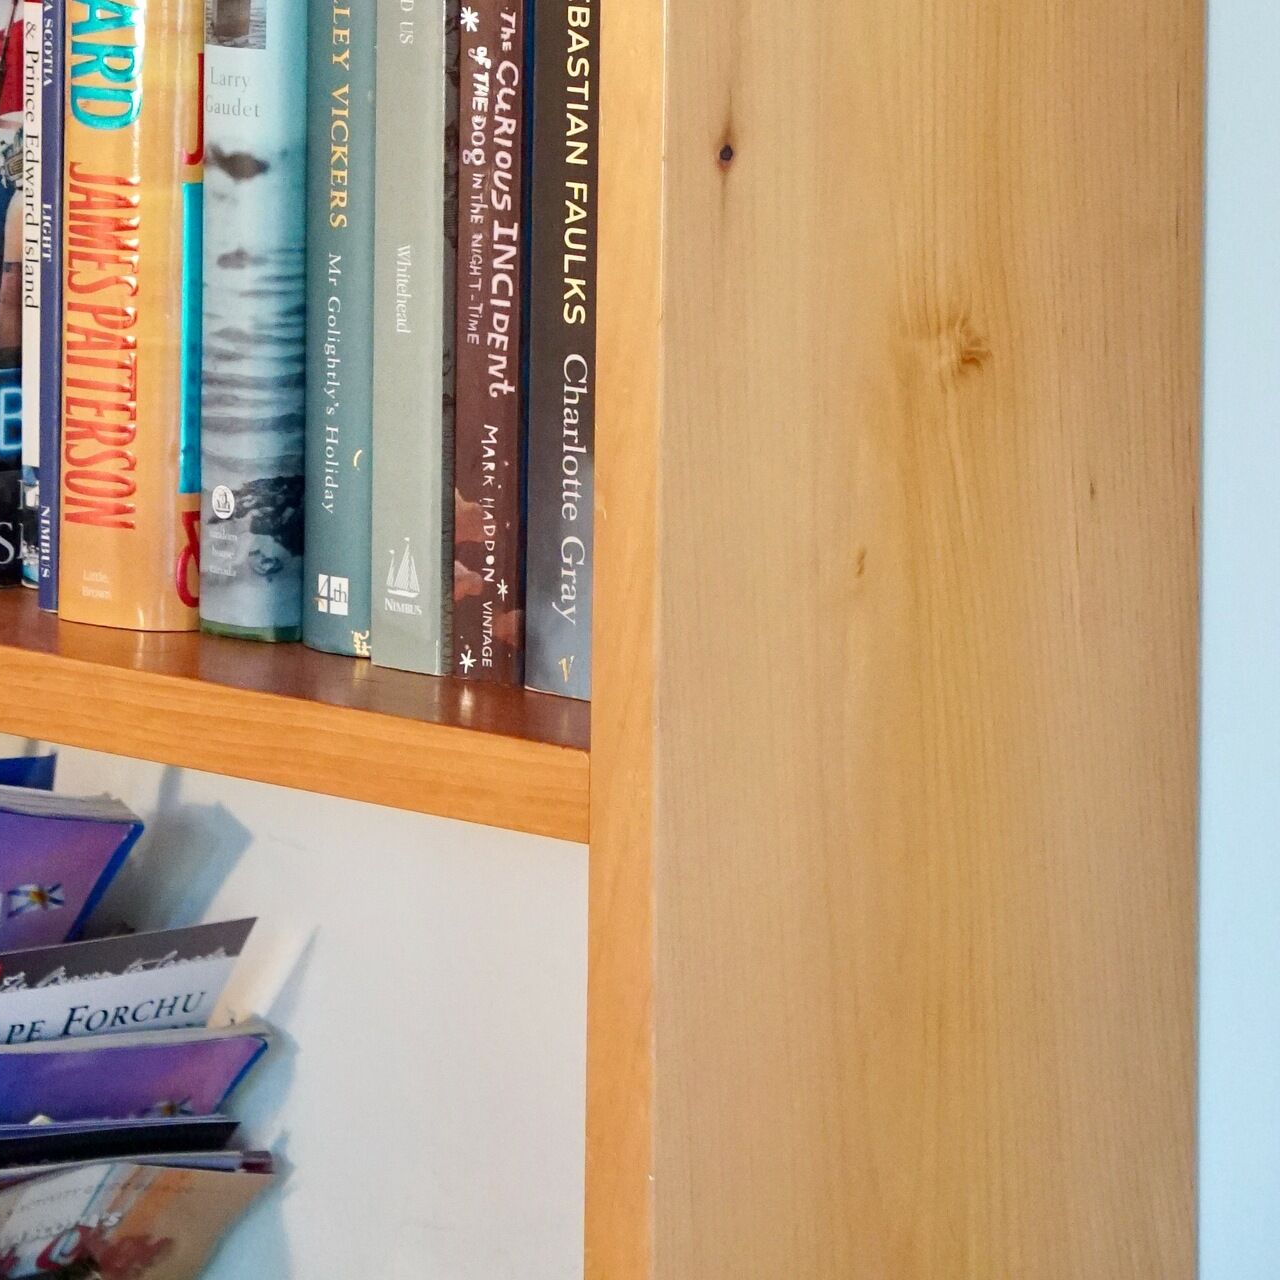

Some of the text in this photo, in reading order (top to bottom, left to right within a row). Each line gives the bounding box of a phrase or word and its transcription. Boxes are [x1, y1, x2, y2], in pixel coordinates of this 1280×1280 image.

[41, 17, 54, 87] SCOTIA
[210, 66, 251, 89] Larry
[399, 20, 413, 45] US
[205, 95, 261, 119] Gaudet
[329, 84, 350, 229] VICKERS
[41, 202, 52, 263] LIGHT
[562, 180, 589, 325] FAULKS
[395, 243, 413, 334] Whitehead
[64, 160, 139, 530] JAMES PATTERSON
[322, 253, 342, 515] Mr Golightly's Holiday
[560, 352, 590, 522] Charlotte
[39, 504, 52, 578] NIMBUS
[480, 423, 500, 667] MARK HADDON VINTAGE
[551, 535, 587, 626] Gray
[384, 597, 422, 616] NIMBUS
